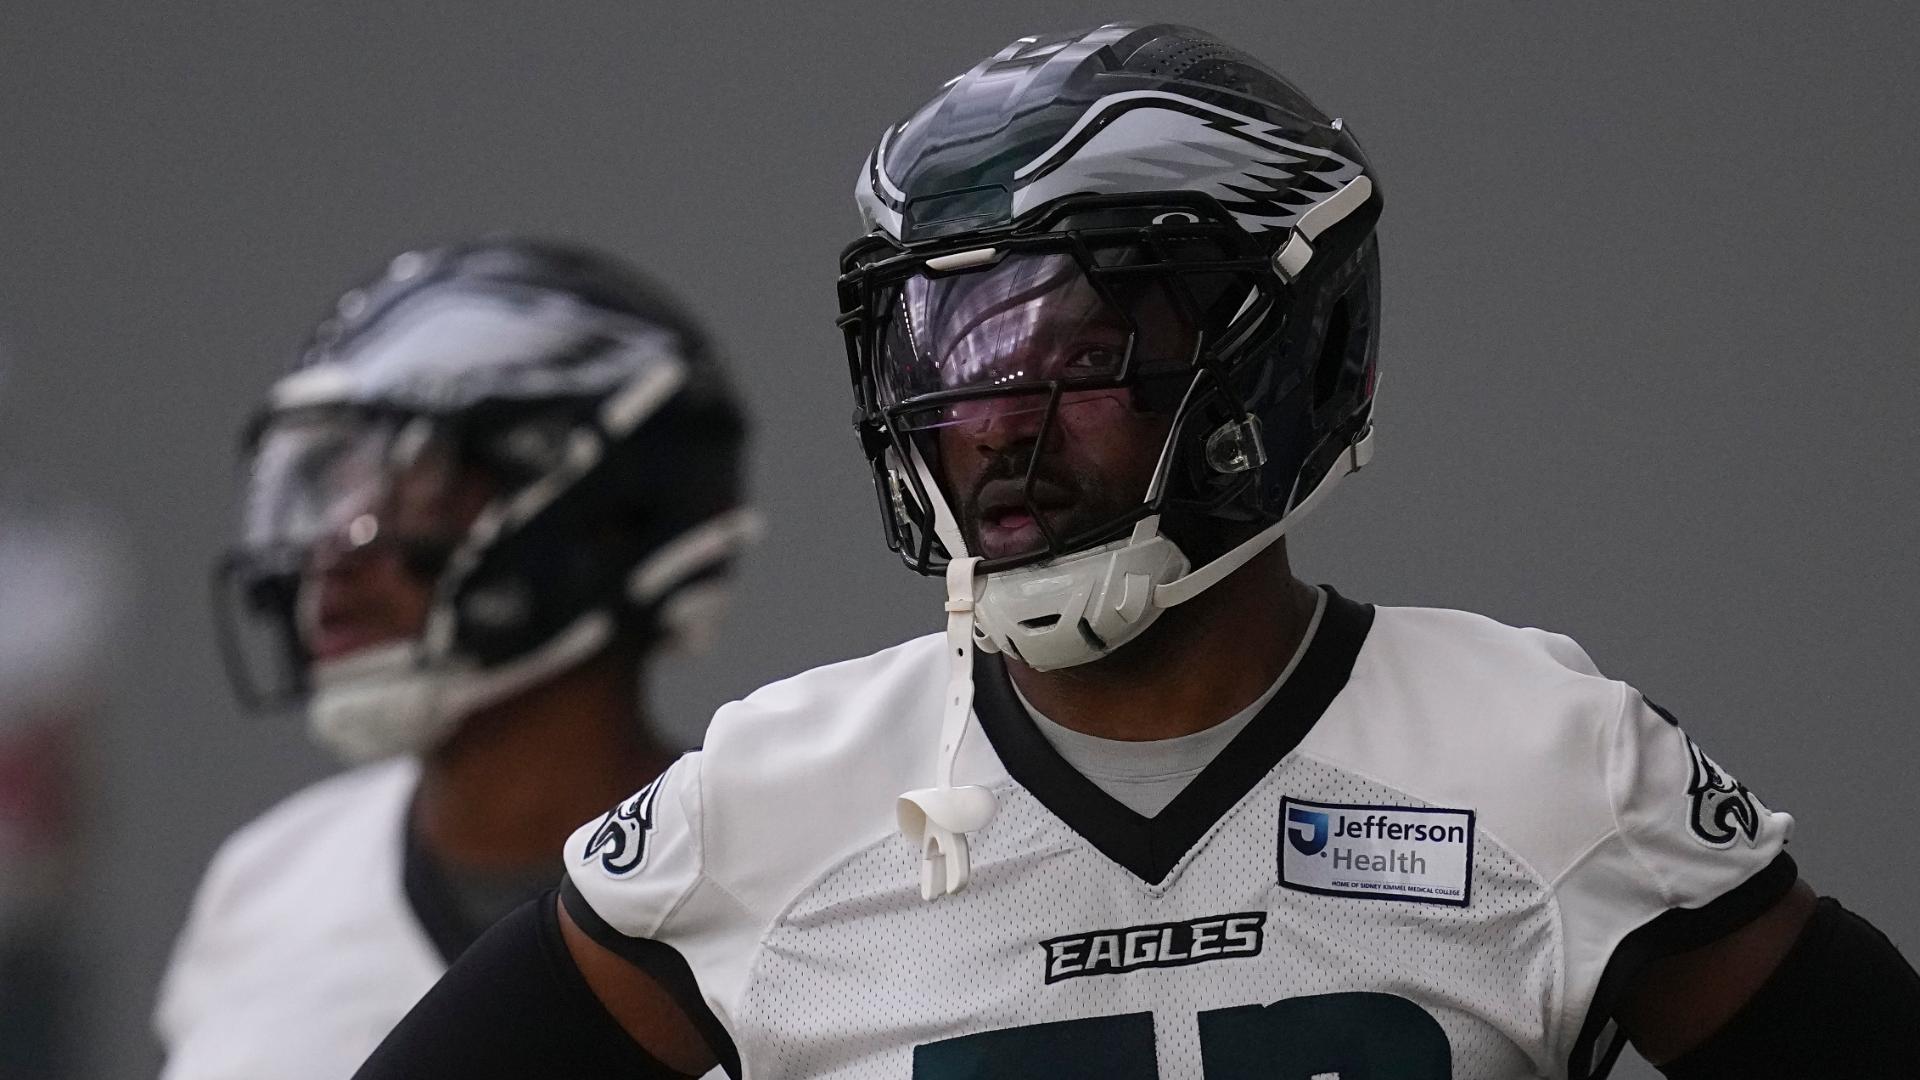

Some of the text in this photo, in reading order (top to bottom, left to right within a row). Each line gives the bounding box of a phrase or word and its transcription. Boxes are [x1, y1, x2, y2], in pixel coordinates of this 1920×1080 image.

[1334, 815, 1464, 843] Jefferson
[1333, 847, 1426, 875] Health
[1408, 886, 1434, 894] MEDICAL
[1435, 888, 1460, 896] COLLEGE
[1047, 917, 1262, 978] EAGLES
